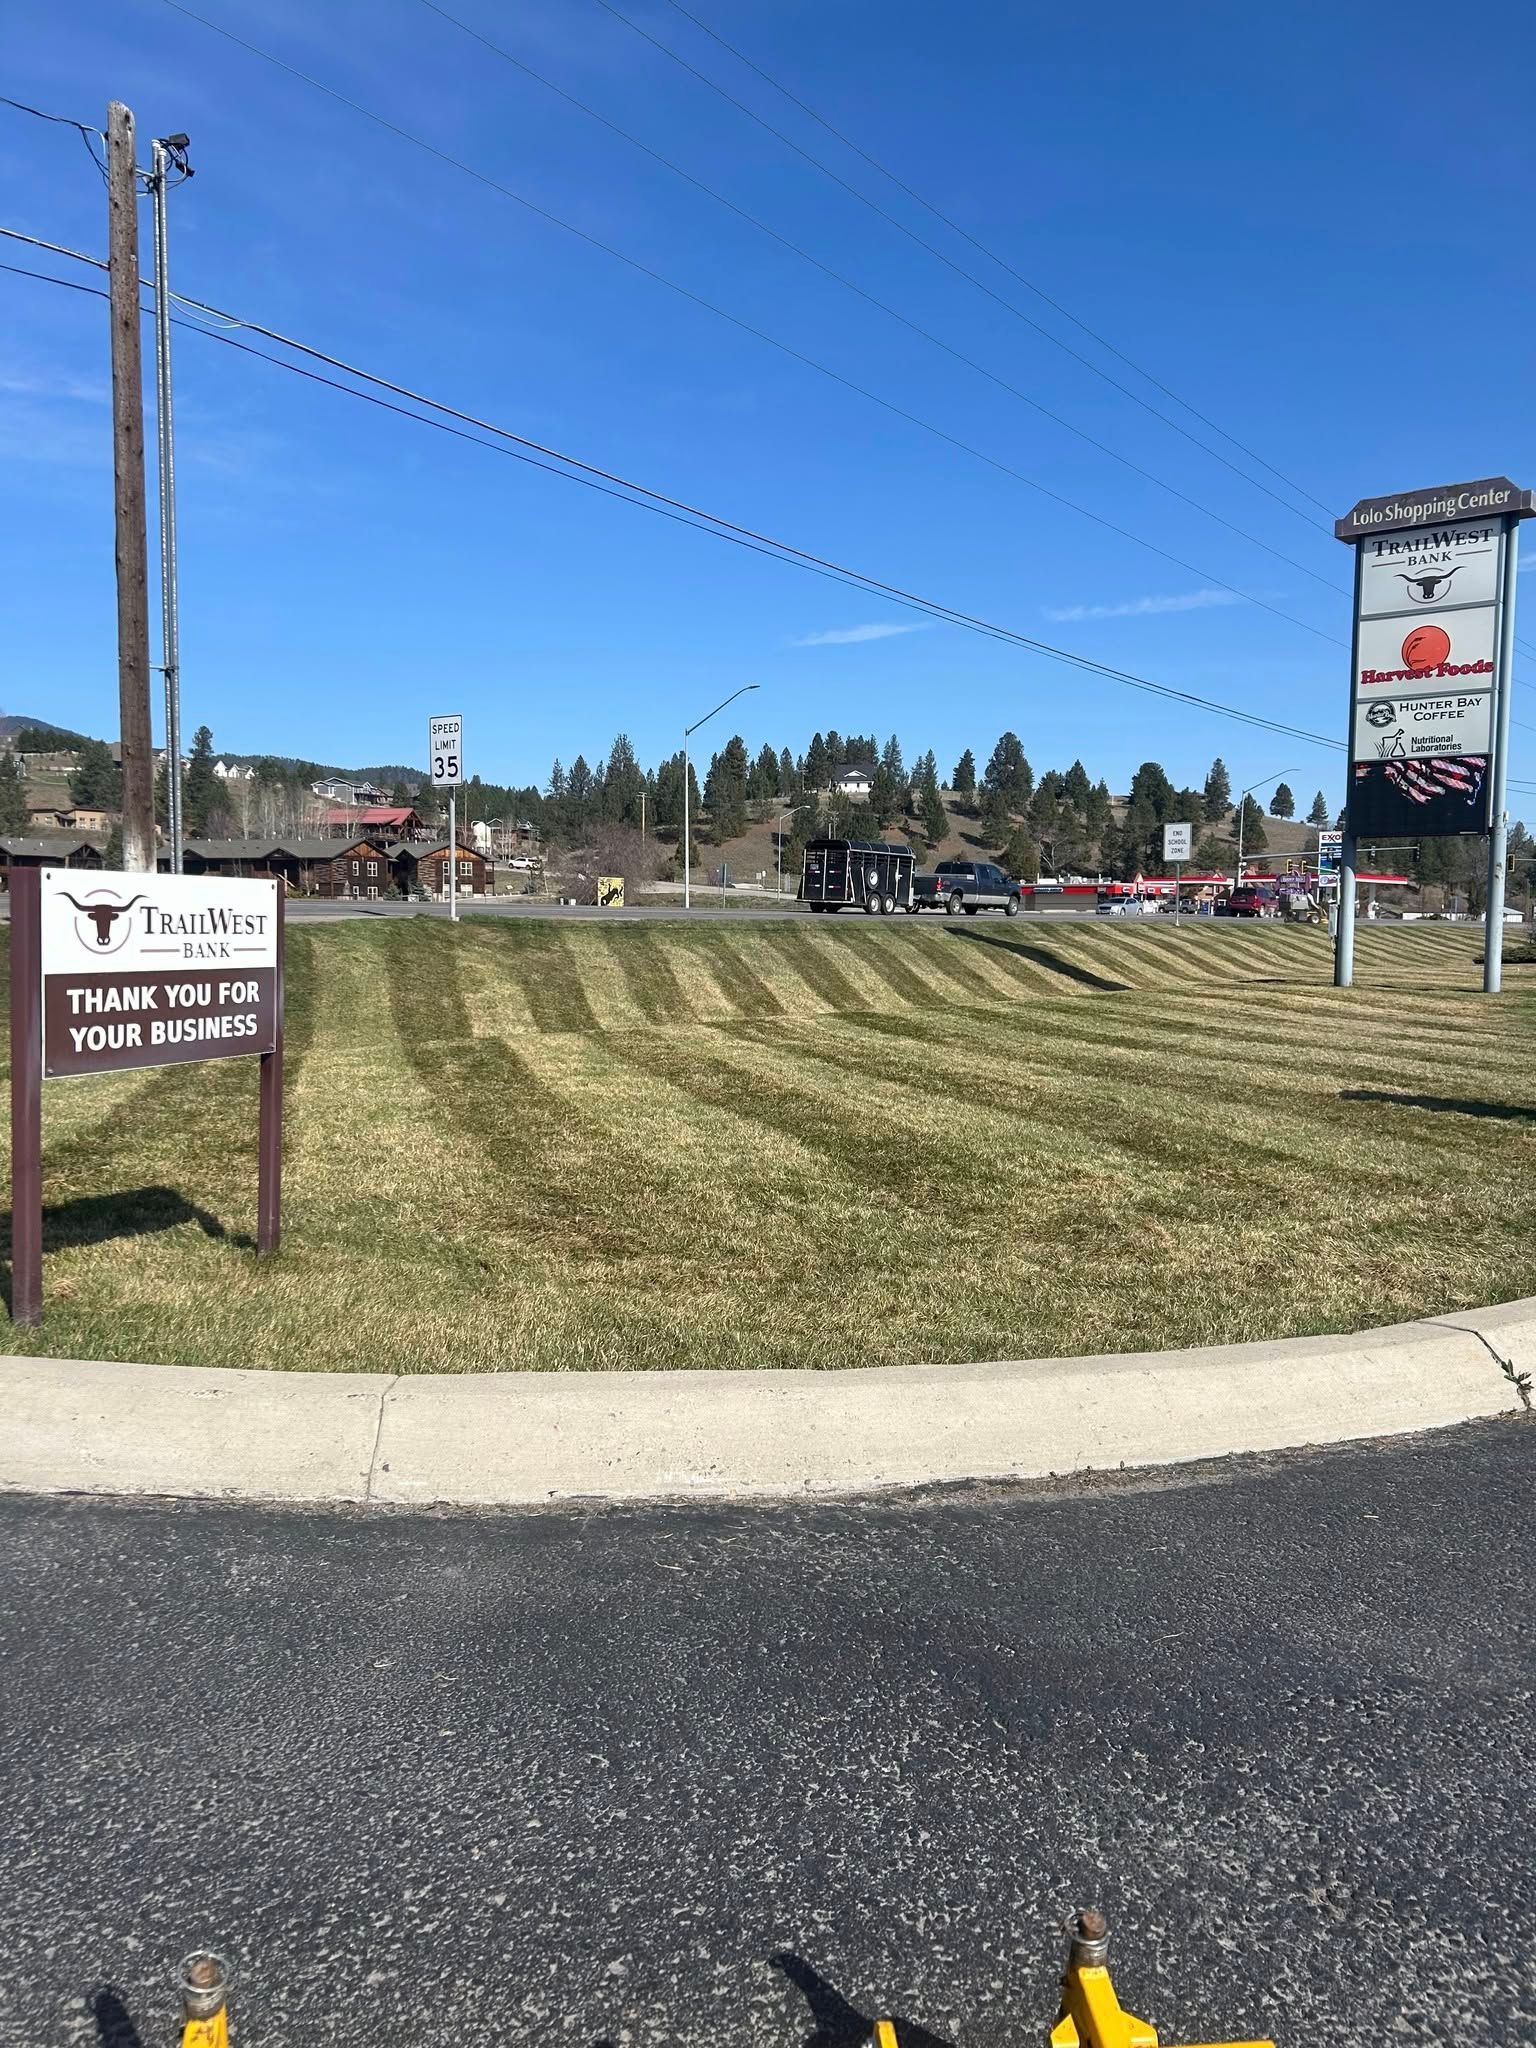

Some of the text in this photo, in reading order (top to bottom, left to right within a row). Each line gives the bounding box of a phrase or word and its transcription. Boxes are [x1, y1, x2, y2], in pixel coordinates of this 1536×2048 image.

[1353, 488, 1511, 526] Lolo Shopping Center
[1407, 551, 1452, 566] BANK
[1361, 659, 1495, 684] Harvest Foods
[1400, 697, 1482, 712] HUNTER BAY
[1413, 710, 1465, 722] COFFEE
[432, 722, 460, 734] SPEED
[435, 740, 456, 751] LIMIT
[1411, 734, 1454, 745] Nutritional
[1411, 743, 1462, 753] Laboratories
[434, 756, 458, 779] 35
[1321, 834, 1343, 843] EXXO
[183, 942, 231, 958] BANK
[66, 981, 260, 1014] THANK YOU FOR
[69, 1013, 258, 1052] YOUR BUSINESS
